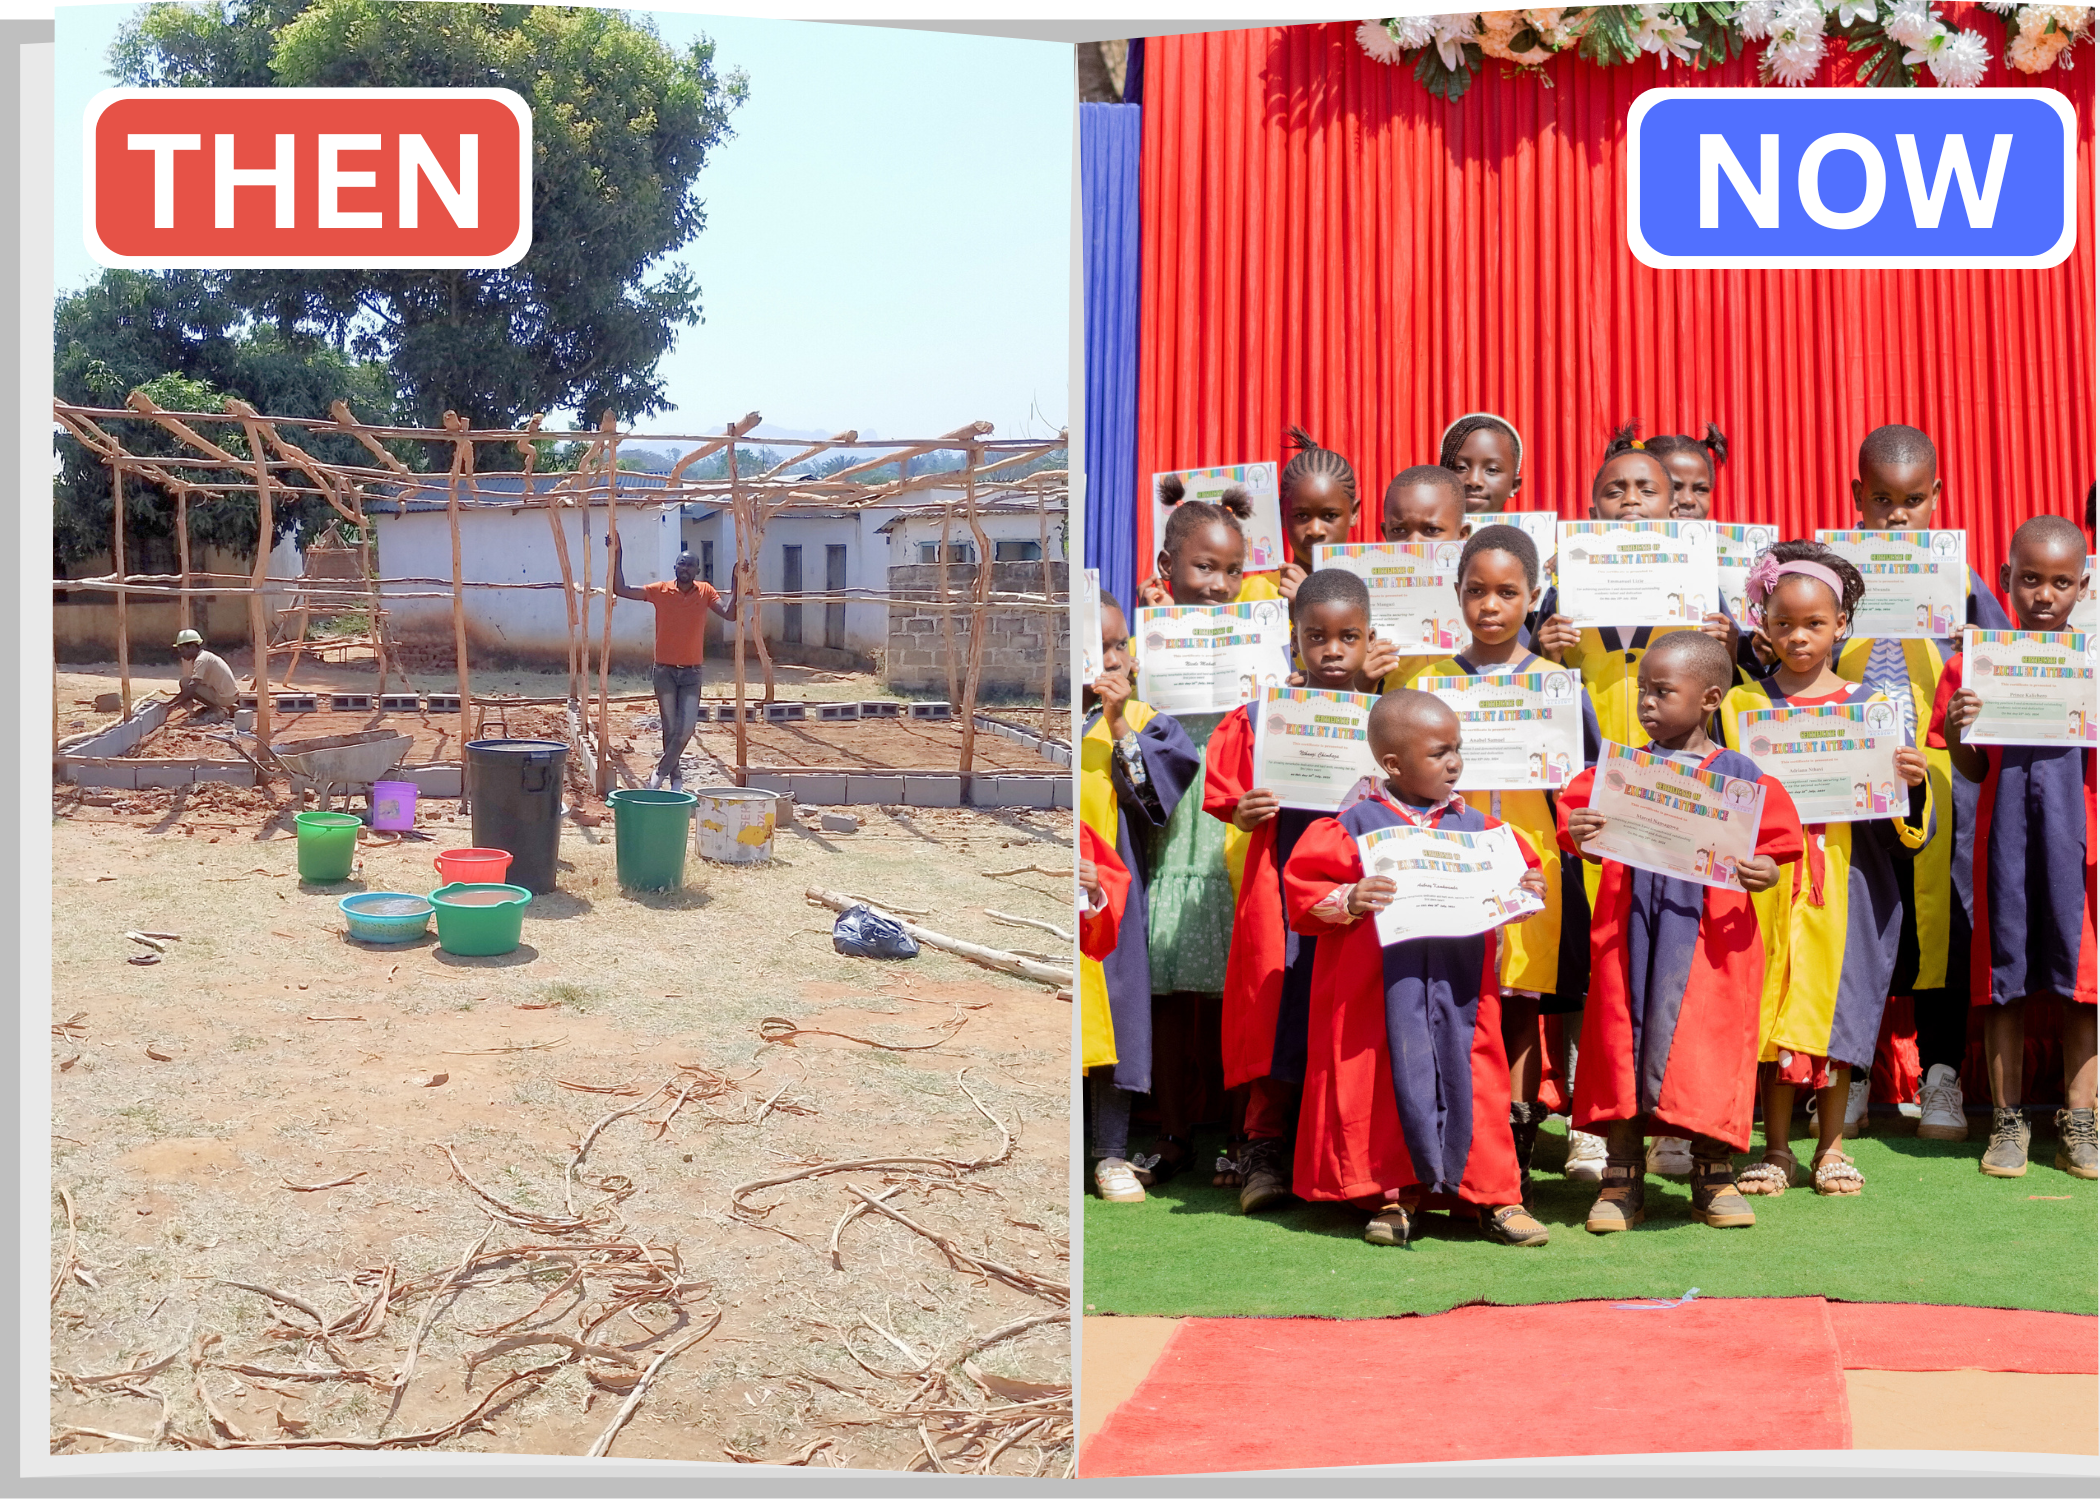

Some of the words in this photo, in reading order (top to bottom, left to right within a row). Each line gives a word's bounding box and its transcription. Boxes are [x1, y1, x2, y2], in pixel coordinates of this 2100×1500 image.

[1589, 554, 1633, 564] EXCELLENT
[1636, 553, 1688, 564] ATTENDANCE
[1888, 564, 1938, 574] ATTENDANCE
[1391, 576, 1443, 588] ATTENDANCE
[1165, 638, 1209, 649] EXCELLENT
[1211, 634, 1261, 648] ATTENDANCE
[2022, 656, 2057, 664] CERTIFICATE
[2058, 657, 2066, 665] OF
[1993, 665, 2038, 677] EXCELLENT
[2040, 667, 2093, 679] ATTENDANCE
[1479, 700, 1515, 708] CERTIFICATE
[1314, 715, 1349, 725] CERTIFICATE
[1498, 708, 1552, 721] ATTENDANCE
[1286, 724, 1330, 737] EXCELLENT
[1332, 727, 1366, 740] ATTEND
[1800, 730, 1836, 739] CERTIFICATE
[1837, 729, 1845, 737] OF
[1772, 741, 1818, 754] EXCELLENT
[1821, 738, 1875, 751] ATTENDANCE
[1656, 781, 1692, 799] CERTIFICATE
[1693, 792, 1701, 801] OF
[1624, 784, 1671, 806] EXCELLENT
[1672, 798, 1729, 821] ATTENDANCE
[1636, 813, 1652, 824] Marcel
[1398, 859, 1439, 871] EXCELLENT
[1442, 861, 1493, 873] ATTENDANCE
